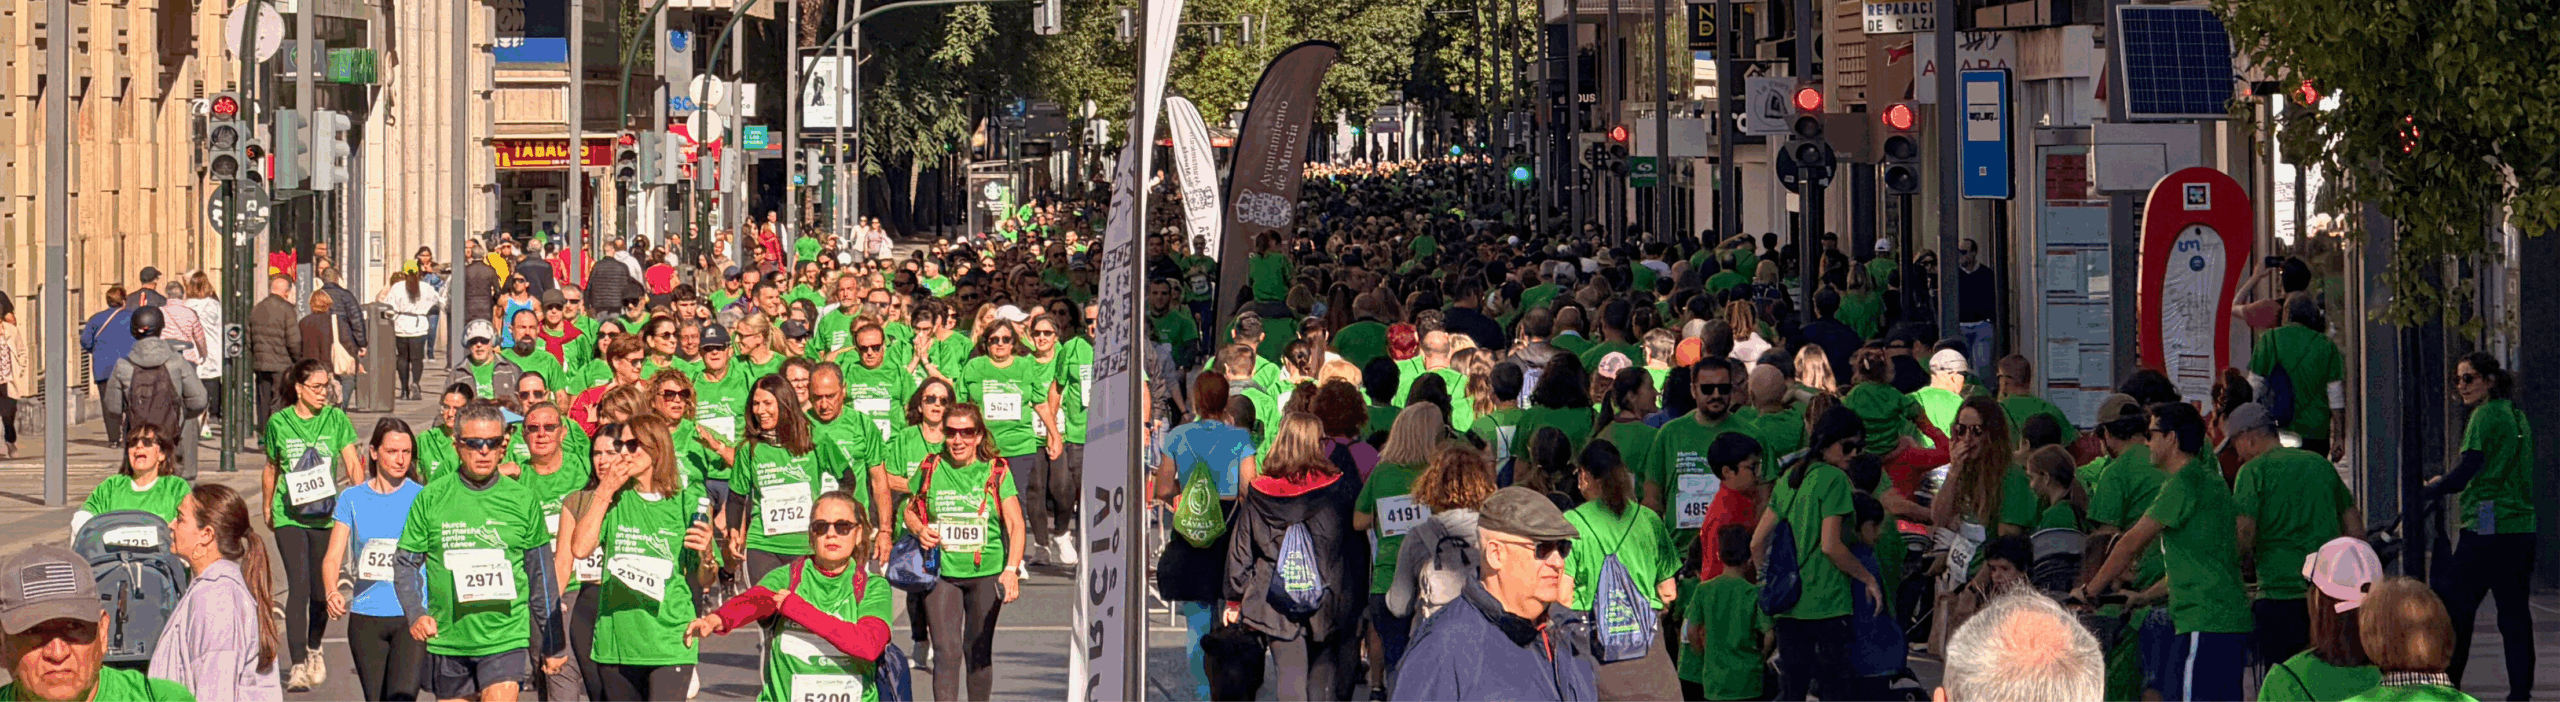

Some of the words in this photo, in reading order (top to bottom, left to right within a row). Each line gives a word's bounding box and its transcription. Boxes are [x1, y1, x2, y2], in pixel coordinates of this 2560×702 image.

[1868, 2, 1934, 16] REPARACI
[1868, 20, 1883, 32] DE
[514, 141, 590, 158] TABACS
[1260, 100, 1289, 188] Ayuntamiento
[1278, 124, 1299, 172] Murcia
[1274, 176, 1286, 190] de
[296, 476, 325, 493] 2303
[770, 506, 805, 522] 2752
[1388, 505, 1421, 523] 4191
[946, 526, 978, 540] 1069
[368, 552, 394, 567] 523
[465, 572, 503, 587] 2971
[618, 568, 654, 587] 2970
